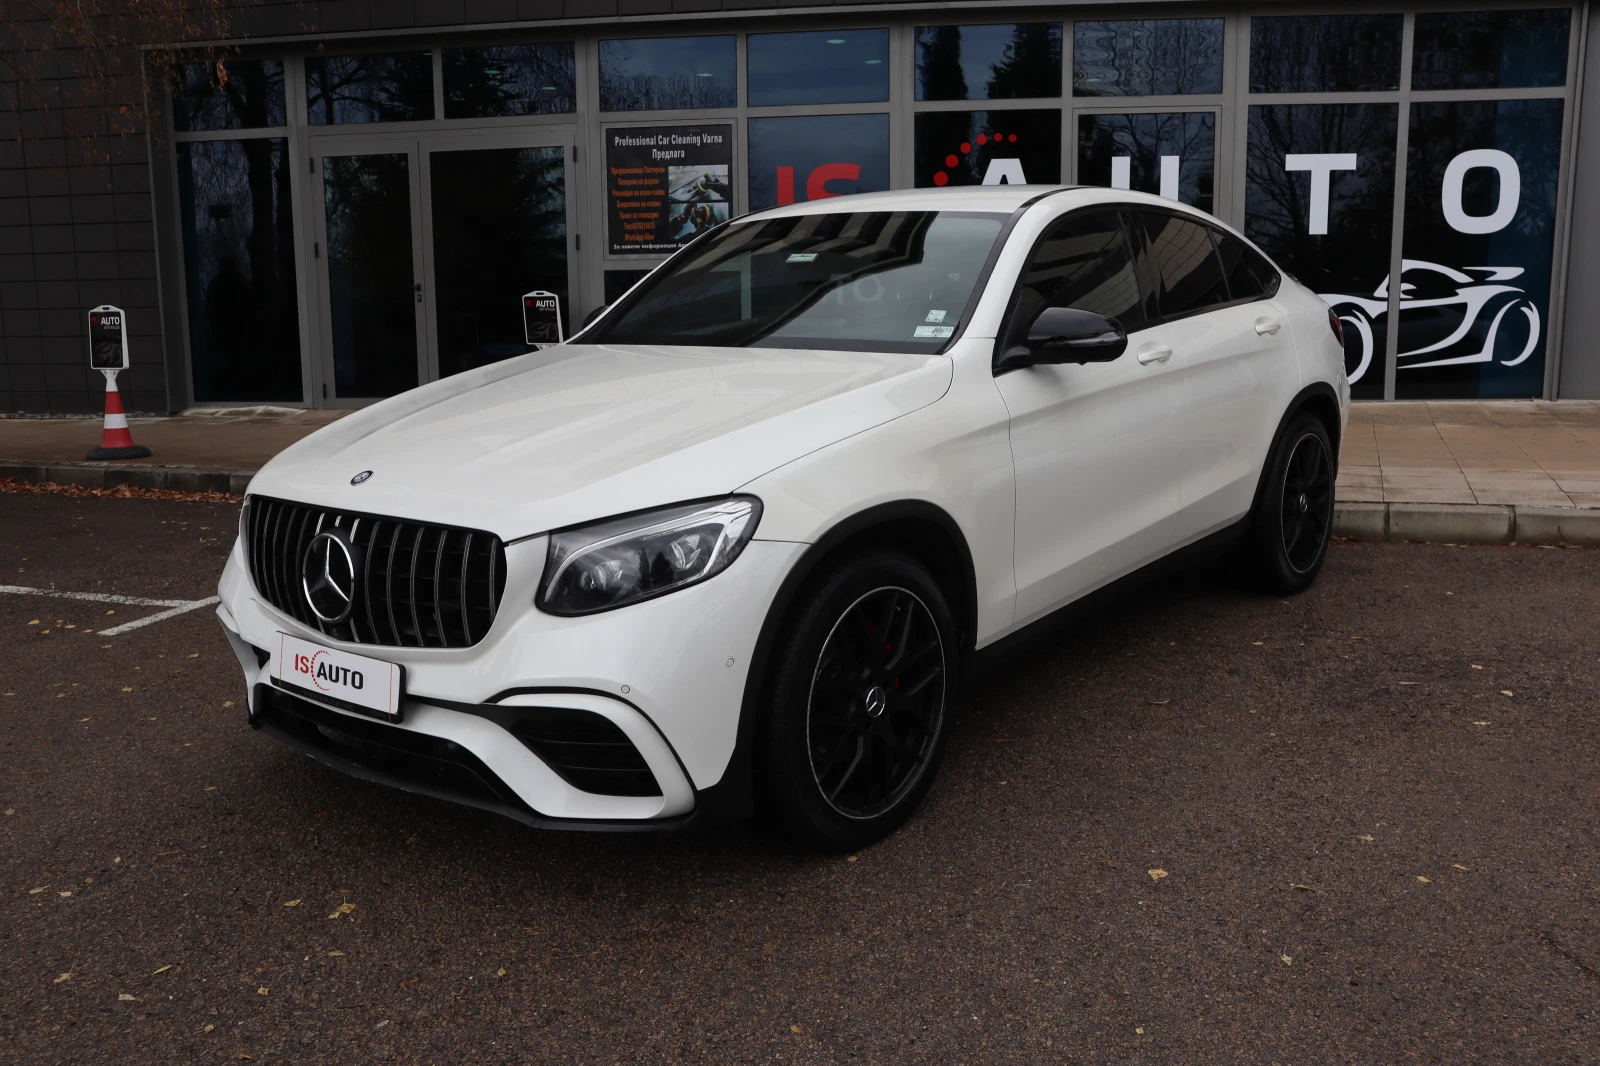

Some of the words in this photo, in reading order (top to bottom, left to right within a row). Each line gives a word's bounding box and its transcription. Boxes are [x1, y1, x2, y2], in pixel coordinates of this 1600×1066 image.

[614, 136, 657, 147] Professional
[658, 136, 670, 145] Car
[671, 135, 701, 147] Cleaning
[702, 134, 723, 144] Varna
[652, 149, 685, 161] Предлага
[536, 300, 555, 308] AUTO
[101, 317, 120, 325] AUTO
[294, 653, 310, 674] IS
[316, 661, 364, 690] AUTO
